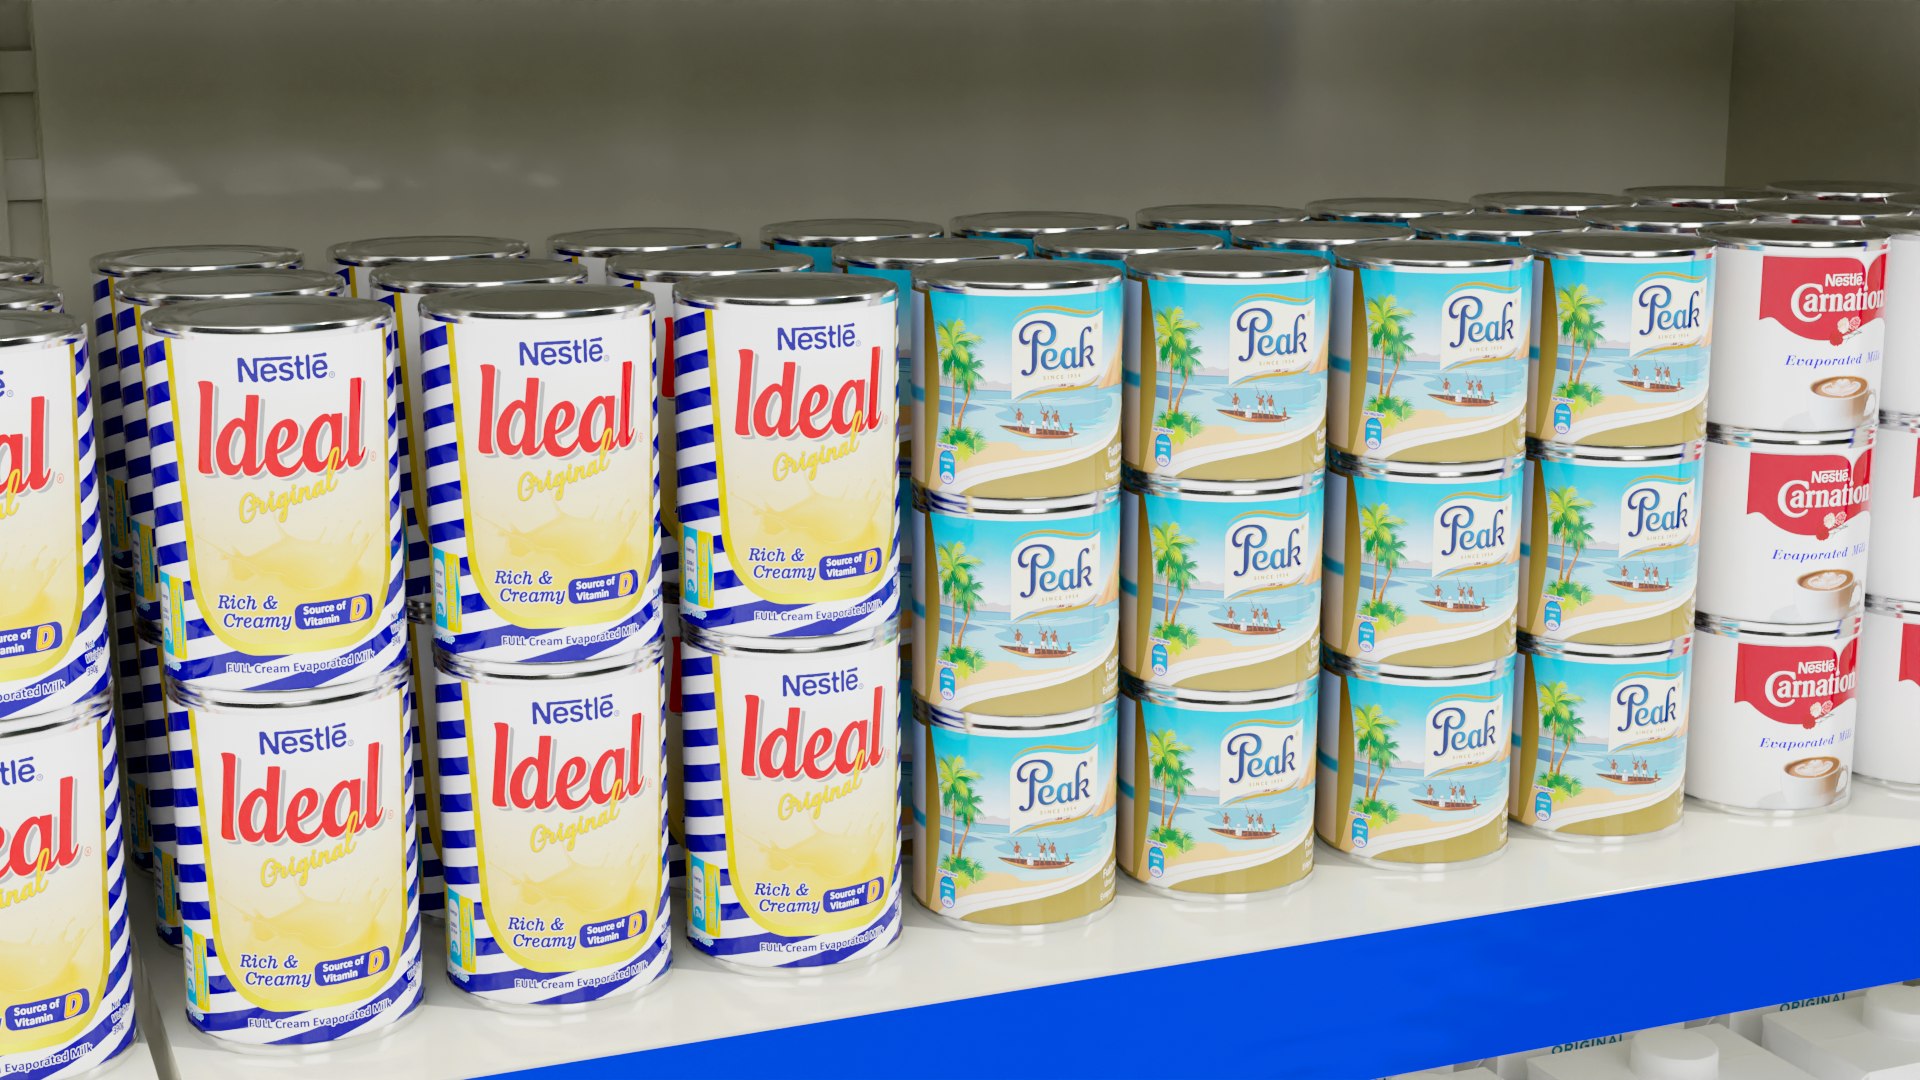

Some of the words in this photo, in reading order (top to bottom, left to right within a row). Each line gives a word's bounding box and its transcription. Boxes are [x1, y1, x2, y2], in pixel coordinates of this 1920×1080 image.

[1639, 284, 1700, 336] Peak
[1791, 283, 1885, 322] Carnation
[1449, 296, 1513, 348] Peak
[1236, 308, 1308, 362] Peak
[1018, 320, 1095, 376] Peak
[1785, 354, 1862, 369] Evaporated
[734, 346, 883, 438] Ideal
[477, 361, 635, 457] Ideal
[198, 377, 366, 478] Ideal
[772, 410, 862, 482] Original
[517, 428, 611, 501] Original
[239, 447, 339, 524] Original
[1778, 480, 1870, 518] Carnation
[1627, 488, 1688, 538] Peak
[1441, 506, 1504, 555] Peak
[749, 548, 785, 562] Rich
[791, 548, 804, 561] &
[826, 558, 852, 567] Source
[854, 554, 862, 563] of
[864, 550, 878, 573] D
[1232, 524, 1302, 577] Peak
[1772, 547, 1848, 563] Evaporated
[495, 571, 532, 585] Rich
[539, 571, 553, 584] &
[754, 565, 816, 581] Creamy
[827, 567, 856, 578] Vitamin
[1017, 543, 1093, 598] Peak
[576, 580, 604, 590] Source
[606, 576, 616, 586] of
[577, 589, 609, 601] Vitamin
[618, 571, 633, 596] D
[218, 595, 256, 609] Rich
[264, 595, 278, 609] &
[303, 605, 334, 615] Source
[336, 601, 346, 611] of
[500, 588, 565, 604] Creamy
[304, 615, 340, 627] Vitamin
[350, 596, 367, 622] D
[755, 611, 778, 621] FULL
[781, 612, 812, 621] Cream
[816, 605, 866, 621] Evaporated
[224, 613, 291, 630] Creamy
[21, 629, 31, 639] of
[36, 625, 55, 651] D
[502, 635, 526, 646] FULL
[530, 636, 562, 646] Cream
[566, 629, 620, 646] Evaporated
[227, 663, 251, 673] FULL
[255, 664, 289, 673] Cream
[294, 656, 353, 674] Evaporated
[355, 650, 374, 664] Milk
[43, 680, 66, 692] Milk
[1765, 670, 1855, 707] Carnation
[1617, 684, 1676, 732] Peak
[740, 685, 884, 779] Ideal
[1433, 707, 1496, 756] Peak
[1760, 735, 1834, 751] Evaporated
[491, 713, 645, 810] Ideal
[1227, 732, 1296, 784] Peak
[220, 742, 383, 844] Ideal
[778, 750, 863, 821] Original
[1016, 757, 1091, 811] Peak
[530, 780, 621, 853] Original
[260, 811, 358, 888] Original
[755, 883, 790, 896] Rich
[796, 883, 809, 896] &
[830, 890, 855, 900] Source
[857, 885, 864, 895] of
[867, 879, 880, 903] D
[760, 899, 820, 914] Creamy
[830, 897, 859, 910] Vitamin
[508, 917, 545, 931] Rich
[551, 918, 564, 931] &
[587, 924, 614, 934] Source
[616, 919, 625, 928] of
[628, 912, 642, 938] D
[513, 934, 576, 949] Creamy
[587, 932, 619, 945] Vitamin
[761, 942, 782, 952] FULL
[786, 943, 816, 952] Cream
[820, 935, 868, 950] Evaporated
[240, 954, 278, 969] Rich
[284, 954, 298, 968] &
[323, 961, 353, 972] Source
[355, 955, 364, 966] of
[368, 950, 384, 975] D
[245, 972, 311, 987] Creamy
[323, 970, 358, 983] Vitamin
[515, 979, 539, 989] FULL
[542, 980, 574, 989] Cream
[578, 970, 630, 987] Evaporated
[14, 1003, 47, 1016] Source
[49, 999, 60, 1009] of
[64, 992, 83, 1018] D
[250, 1018, 272, 1028] FULL
[276, 1019, 309, 1028] Cream
[314, 1010, 370, 1027] Evaporated
[373, 998, 392, 1013] Milk
[14, 1014, 53, 1027] Vitamin
[5, 1051, 68, 1072] Evaporated
[71, 1042, 93, 1058] Milk
